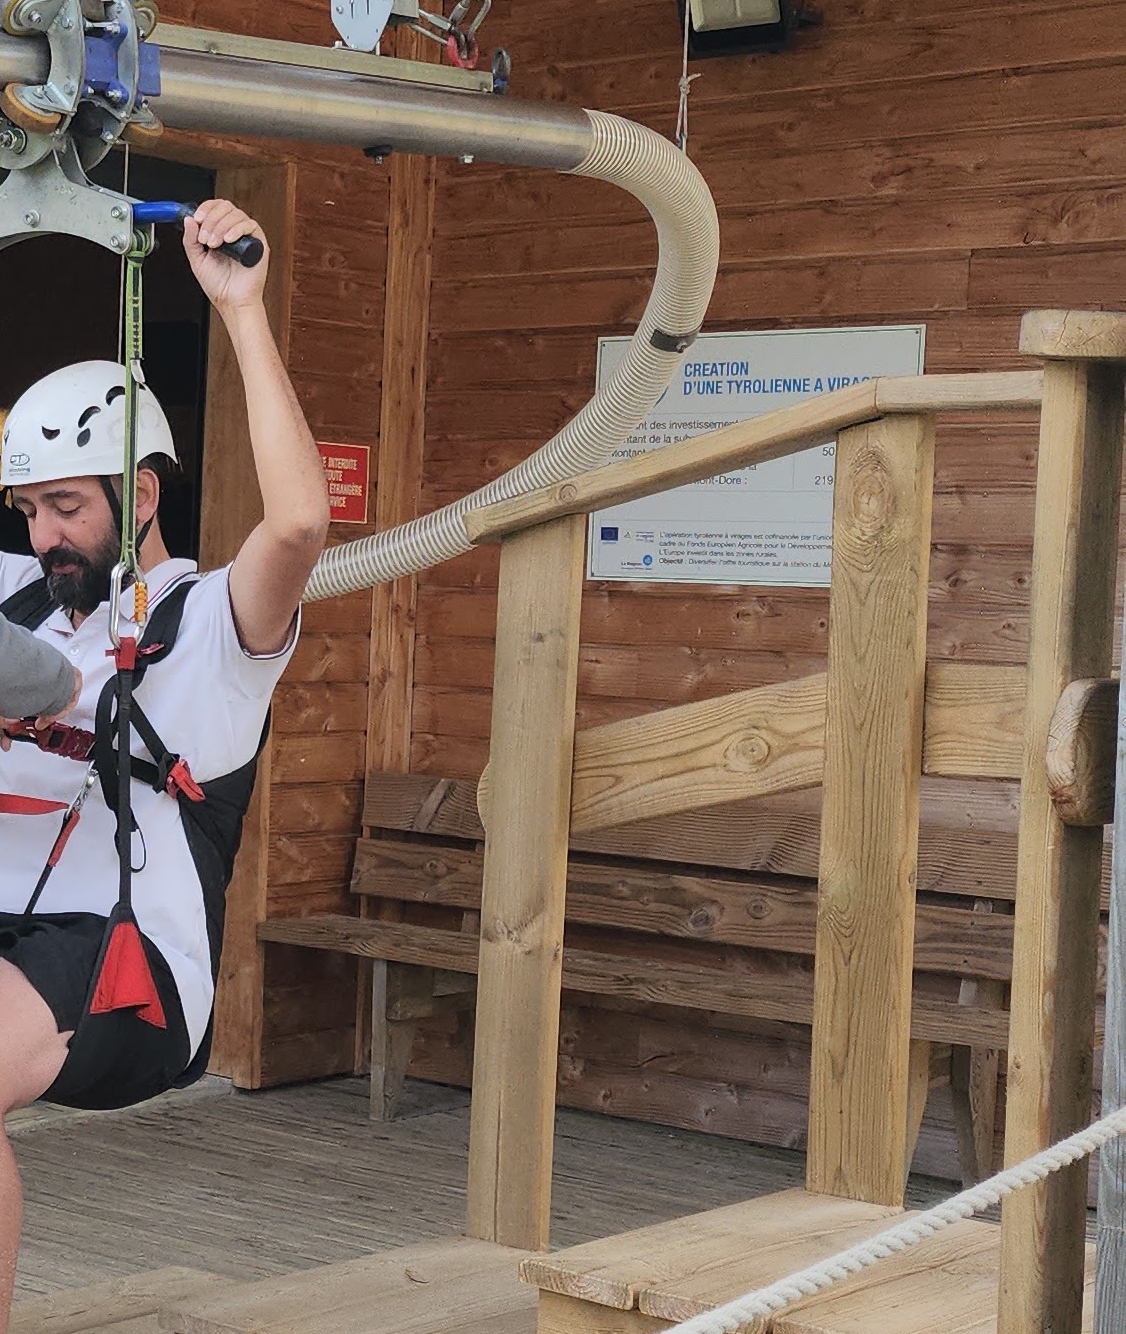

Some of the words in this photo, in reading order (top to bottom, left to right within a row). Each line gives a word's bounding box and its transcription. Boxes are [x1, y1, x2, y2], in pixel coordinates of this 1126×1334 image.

[684, 361, 749, 377] CREATION
[683, 380, 723, 396] D'UNE
[726, 378, 810, 394] TYROLIENNE
[814, 378, 823, 392] A
[650, 420, 666, 430] des
[648, 435, 661, 444] de
[663, 435, 671, 444] la
[695, 476, 741, 485] ont-Dore
[815, 476, 833, 485] 219
